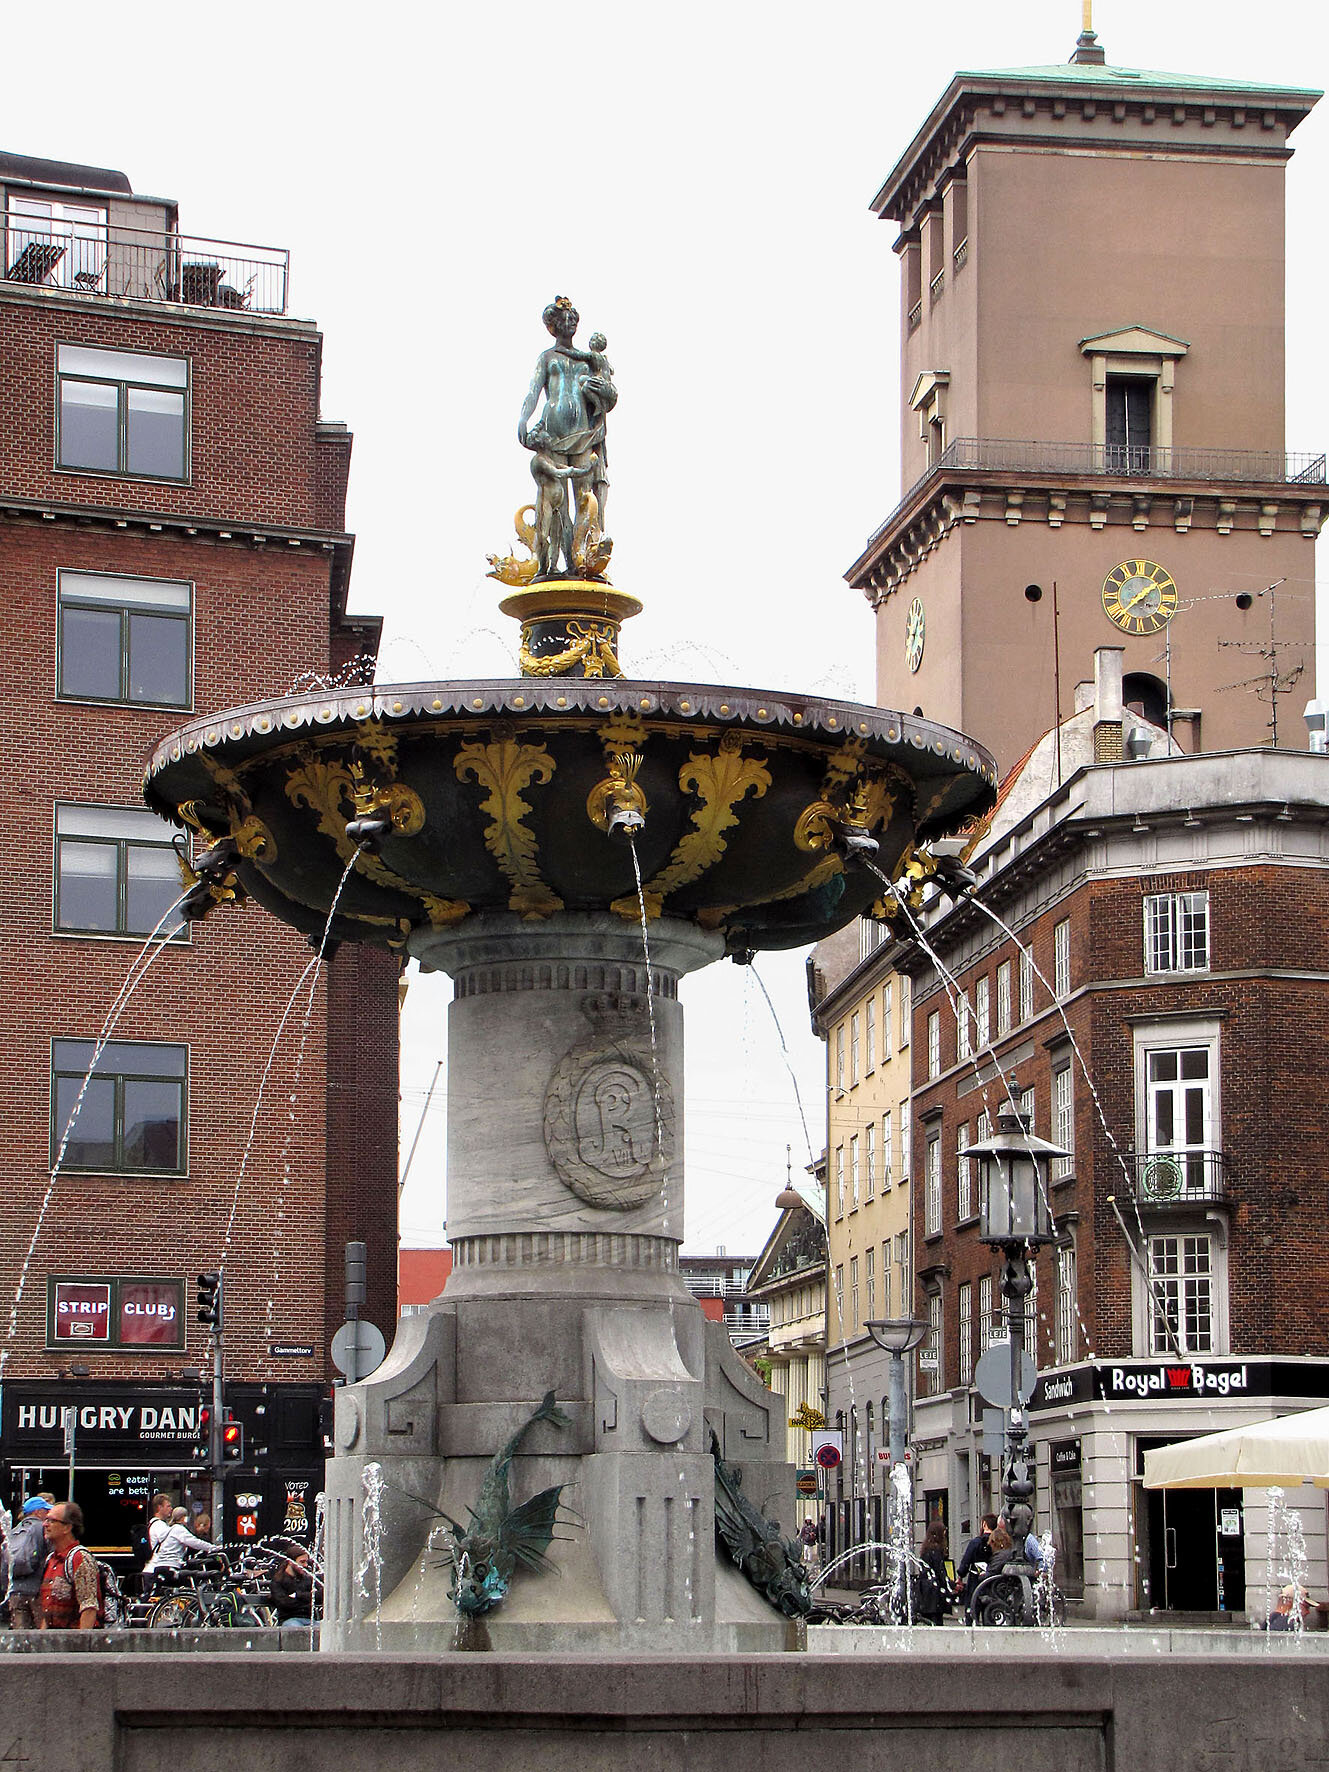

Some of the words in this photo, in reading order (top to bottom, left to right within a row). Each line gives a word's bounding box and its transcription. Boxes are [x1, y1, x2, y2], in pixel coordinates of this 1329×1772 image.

[58, 1301, 108, 1314] STRIP
[124, 1303, 168, 1316] CLUB
[989, 1330, 1007, 1338] LEJE
[1112, 1367, 1166, 1397] Royal
[1192, 1365, 1247, 1395] Bagel
[1044, 1375, 1073, 1401] Sandwich
[139, 1431, 176, 1439] GOURMET
[128, 1487, 160, 1495] bettr
[285, 1481, 310, 1490] VOTED
[283, 1518, 309, 1532] 2019
